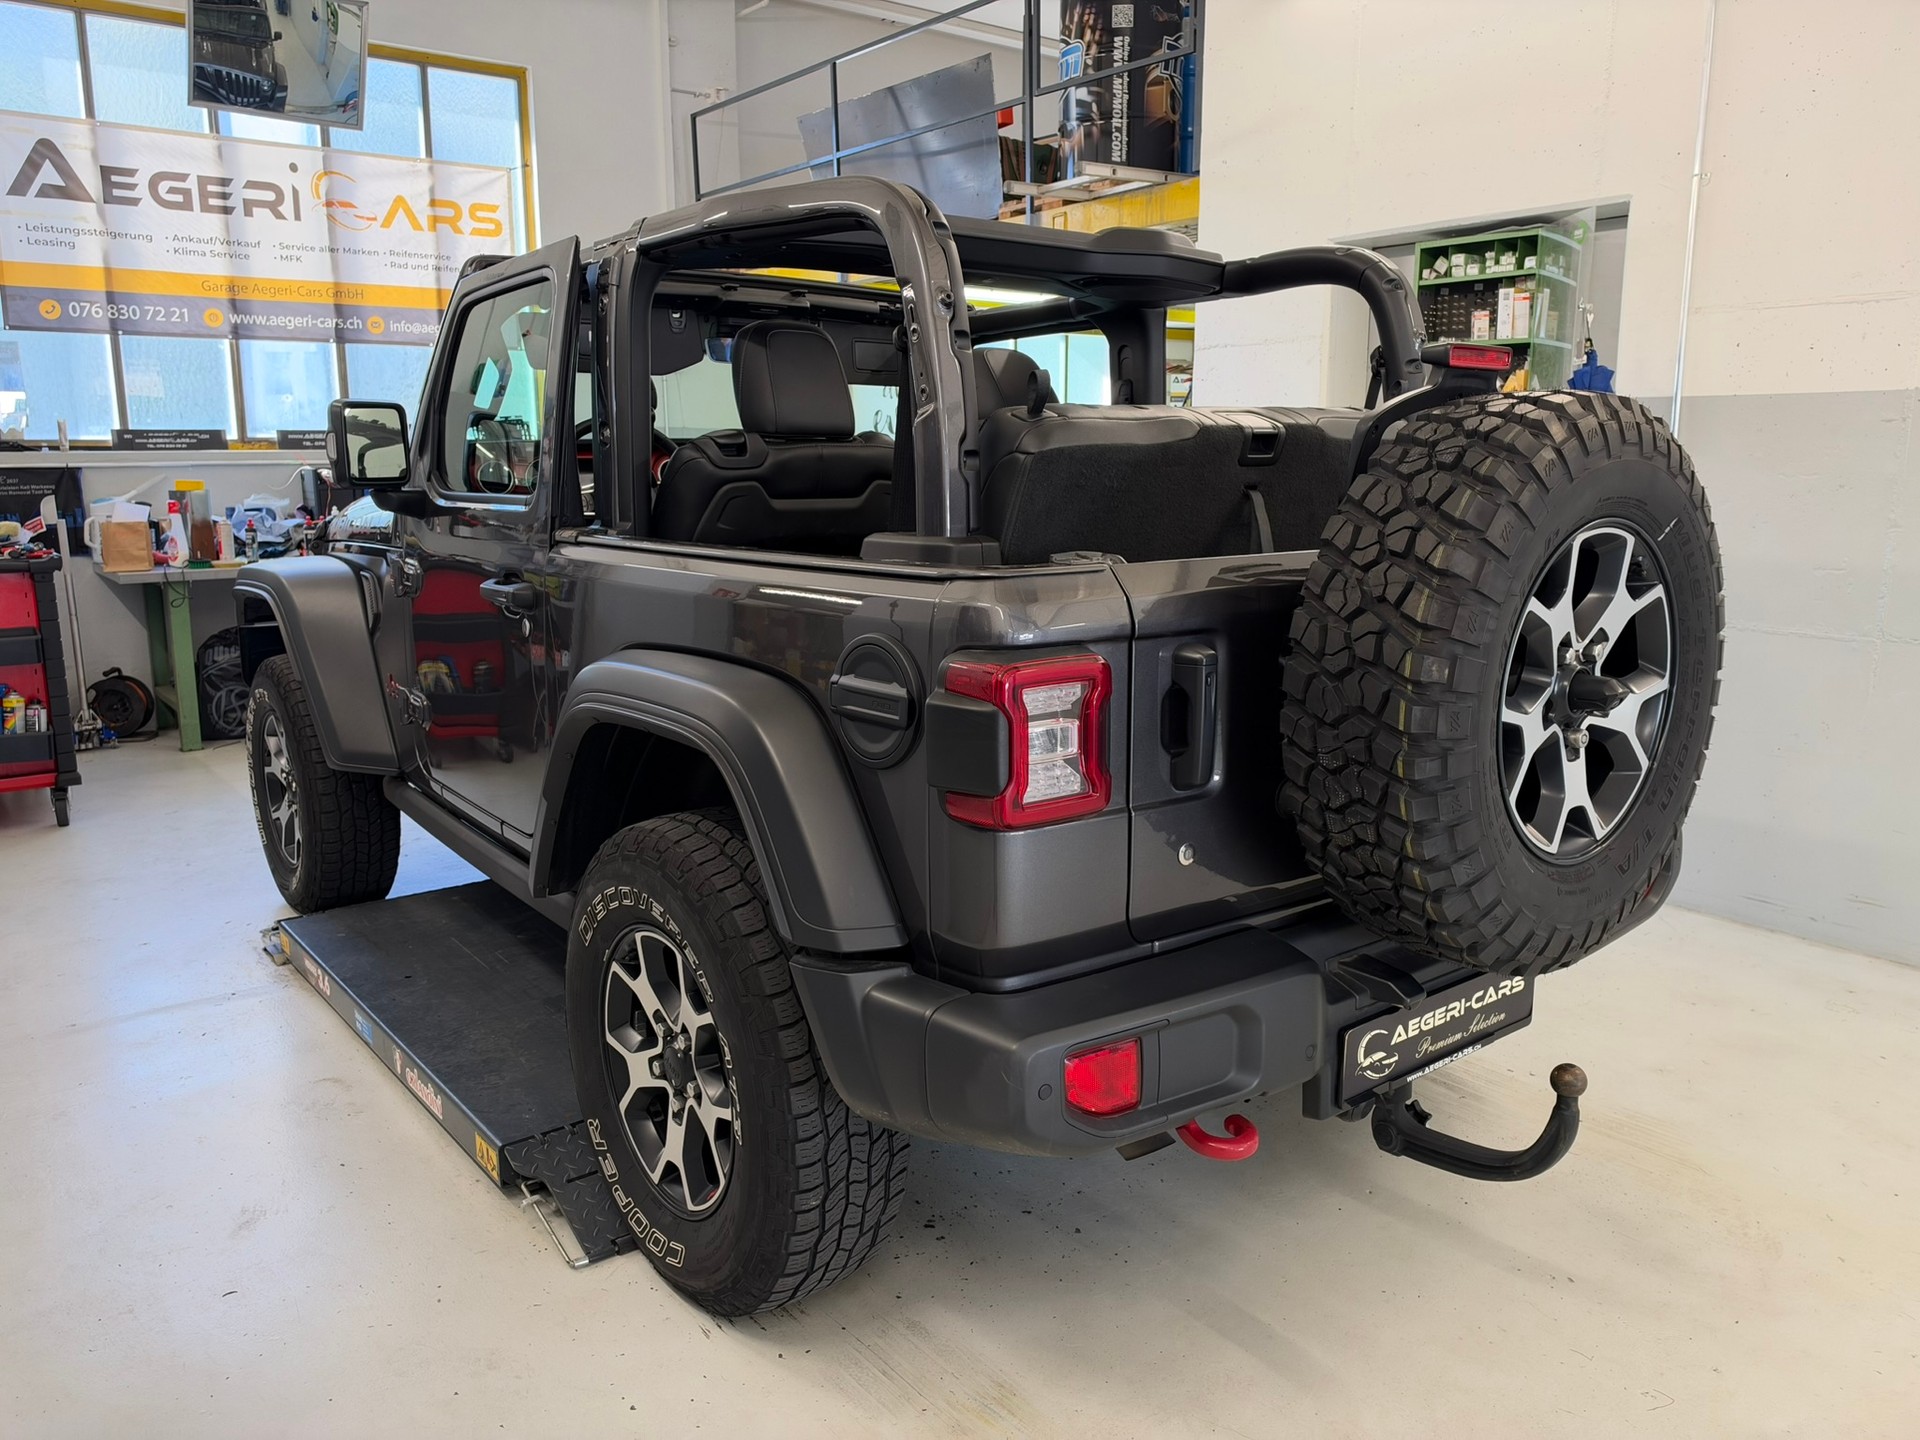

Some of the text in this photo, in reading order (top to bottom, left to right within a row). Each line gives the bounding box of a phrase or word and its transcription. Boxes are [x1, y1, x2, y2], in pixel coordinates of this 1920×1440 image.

[1122, 62, 1130, 93] oduct
[25, 223, 153, 243] Leistungssteigerung
[172, 234, 261, 249] Ankauf/Verkauf
[27, 237, 76, 250] Leasing
[278, 242, 380, 257] Service aller Marken
[173, 247, 250, 261] Klima Service
[280, 254, 303, 264] MFK
[389, 250, 452, 261] Reifenservice
[390, 261, 408, 270] Rad
[411, 262, 429, 271] und
[201, 280, 364, 300] Garage Aegeri-Cars GmbH
[68, 302, 104, 319] 076
[107, 304, 141, 320] 830
[144, 306, 166, 322] 72
[170, 308, 189, 323] 21
[229, 312, 362, 331] www.aegeri-cars.ch
[578, 886, 715, 1004] DISCOVERER
[1390, 975, 1526, 1046] AEGERI-CARS
[1415, 1012, 1507, 1059] Premium Selection
[586, 1118, 686, 1268] COOPER
